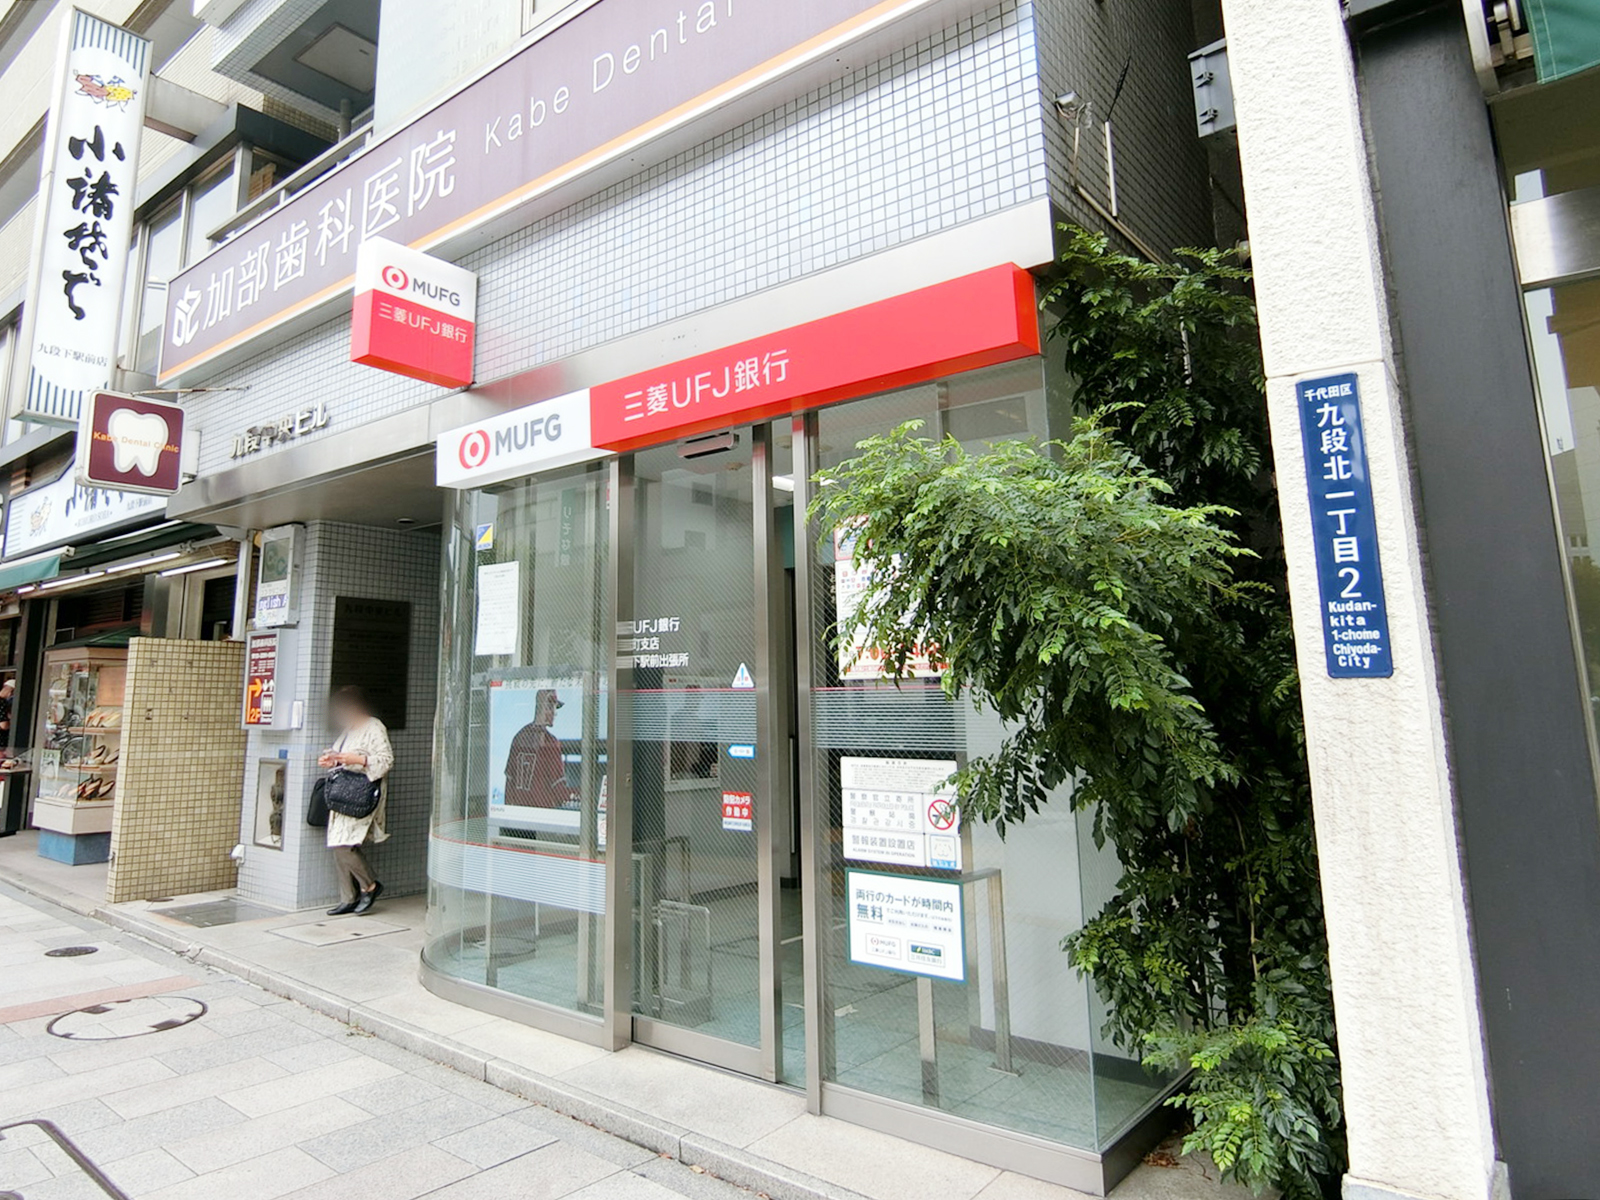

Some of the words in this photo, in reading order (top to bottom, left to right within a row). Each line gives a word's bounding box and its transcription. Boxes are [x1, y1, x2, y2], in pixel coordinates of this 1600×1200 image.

[484, 86, 570, 154] Kabe
[203, 128, 456, 331] 加部歯科医院
[413, 278, 460, 307] MUFG
[379, 302, 467, 343] 三菱UFJ銀行
[623, 349, 790, 422] 三菱UFJ銀行
[1304, 383, 1353, 402] 千代田区
[495, 413, 562, 456] MUFG
[1328, 601, 1377, 613] Kudan-
[1329, 615, 1366, 627] kita
[1331, 628, 1381, 641] 1-chome
[1332, 642, 1382, 657] Chiyoda-
[1338, 656, 1371, 669] City
[856, 888, 953, 913] 両行のカードが時間内
[856, 903, 884, 921] 無料
